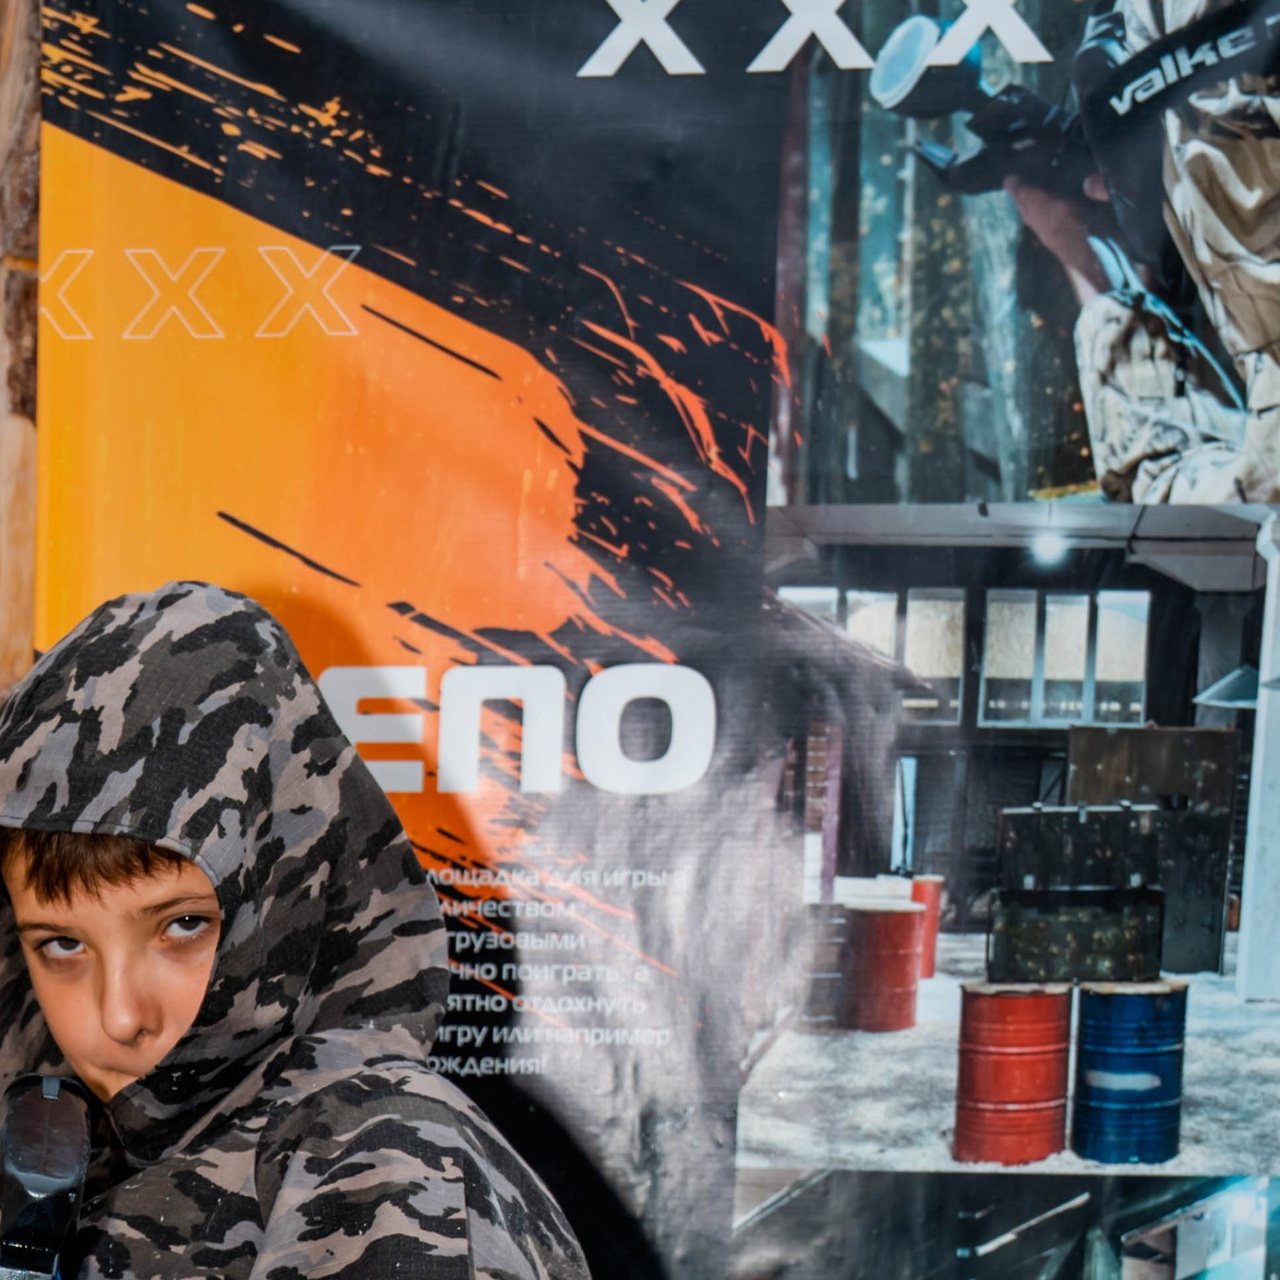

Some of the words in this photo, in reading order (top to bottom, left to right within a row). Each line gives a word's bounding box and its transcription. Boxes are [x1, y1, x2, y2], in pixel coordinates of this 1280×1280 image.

[1108, 13, 1280, 116] valke
[317, 662, 716, 795] ЕПО
[603, 868, 666, 890] игры
[512, 994, 648, 1017] отдохнуть
[492, 1026, 538, 1044] или
[544, 1026, 670, 1048] например
